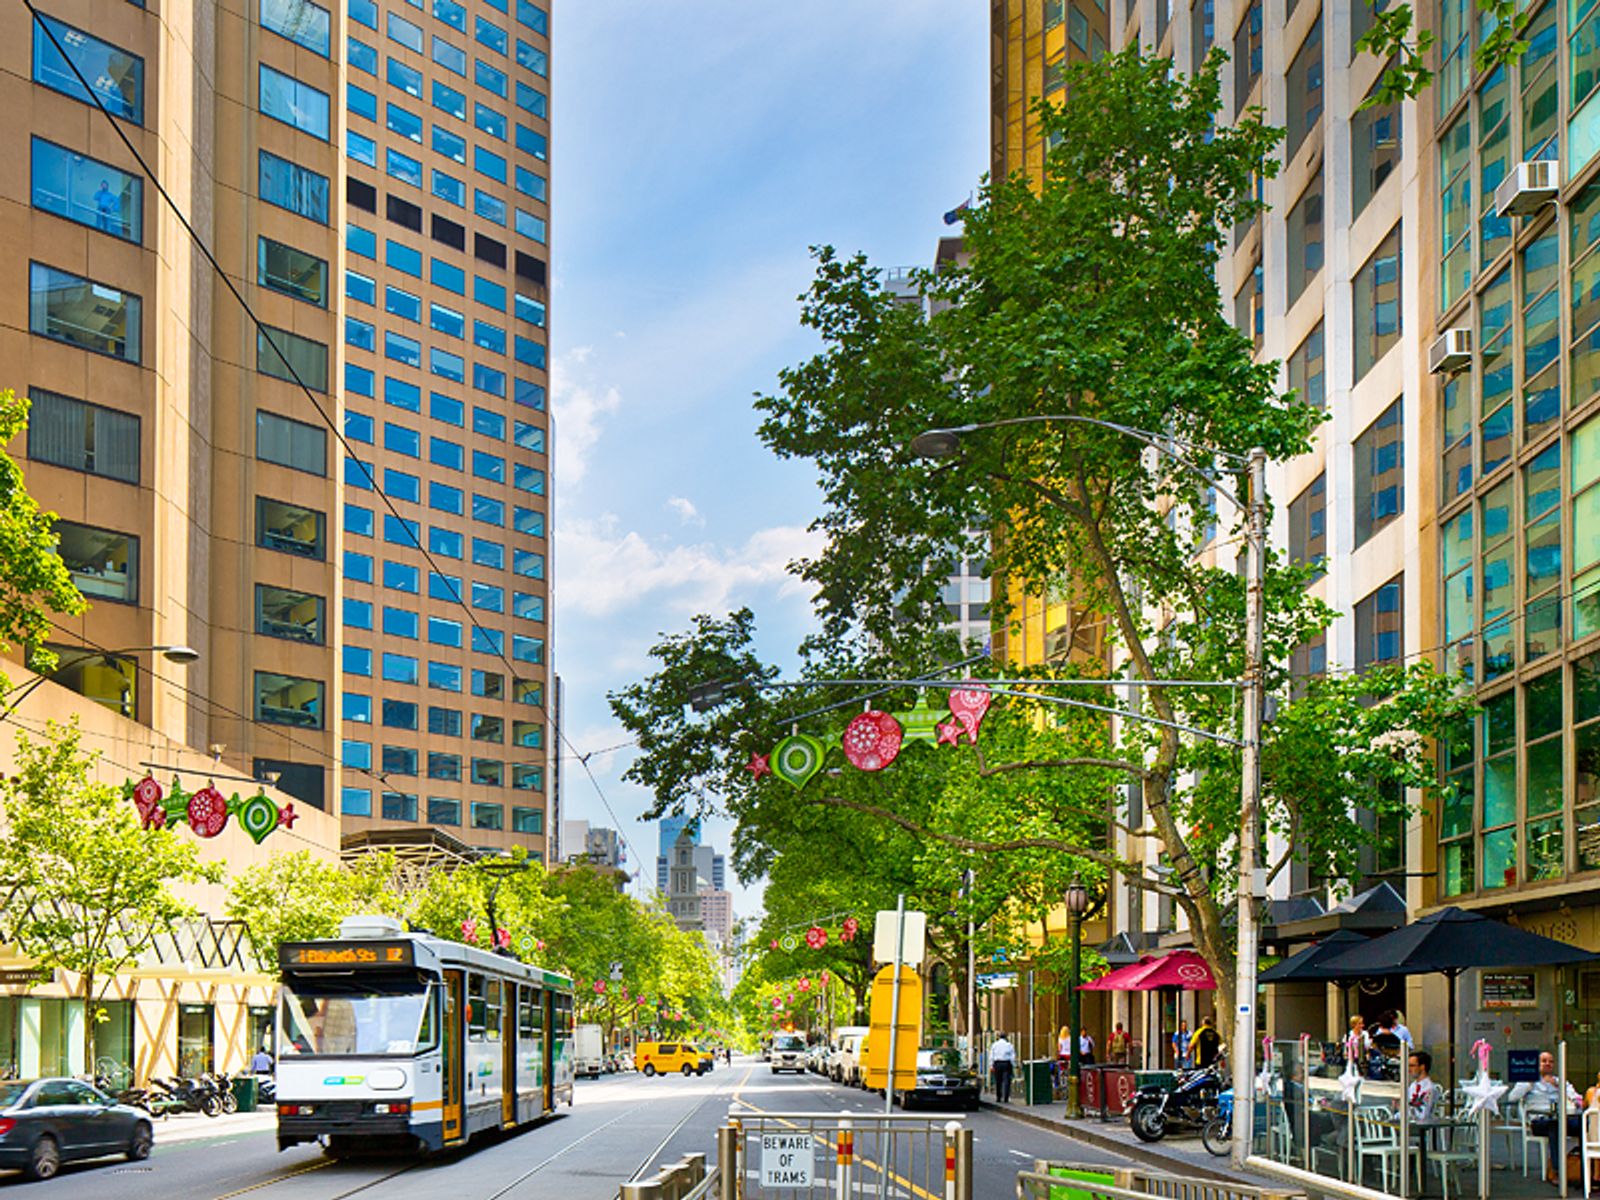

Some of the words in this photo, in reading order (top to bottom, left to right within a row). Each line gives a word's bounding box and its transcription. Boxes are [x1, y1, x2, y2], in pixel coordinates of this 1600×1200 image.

[763, 1136, 810, 1149] BEWARE
[779, 1154, 794, 1167] OF
[768, 1171, 807, 1183] TRAMS
